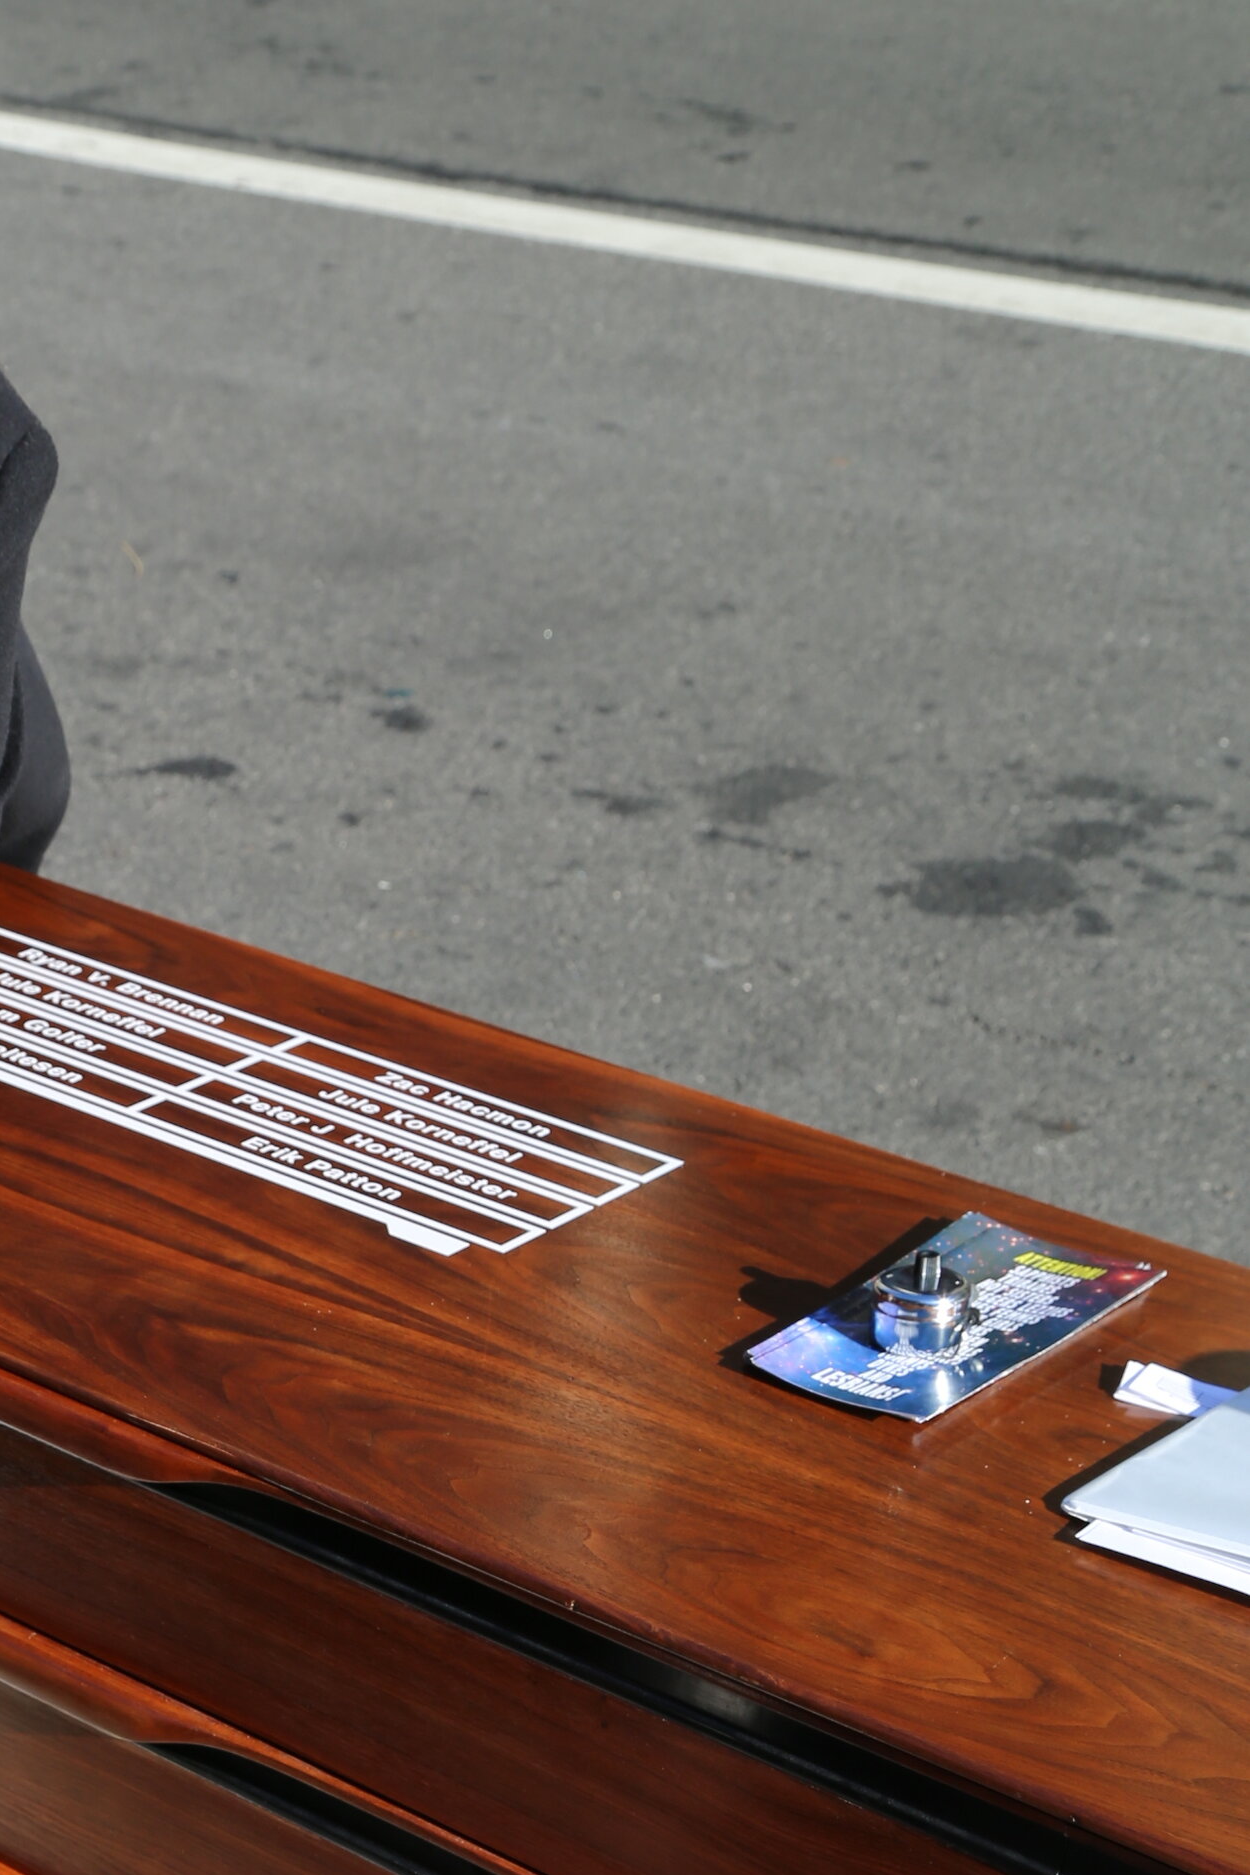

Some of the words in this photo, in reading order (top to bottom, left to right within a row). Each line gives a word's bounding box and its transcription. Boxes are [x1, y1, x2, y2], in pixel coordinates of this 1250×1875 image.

[17, 947, 83, 977] Ryan
[86, 970, 111, 987] V.
[115, 981, 225, 1026] Brennan
[42, 990, 166, 1038] Korneffel
[318, 1087, 381, 1117] Jule
[383, 1108, 524, 1165] Korneffel
[374, 1070, 432, 1097] Zac
[433, 1090, 552, 1139] Hacmon
[231, 1092, 311, 1127] Peter
[311, 1121, 336, 1136] J
[343, 1132, 519, 1201] Hoffmeister
[240, 1135, 304, 1166] Erik
[304, 1157, 402, 1202] Patton
[1013, 1251, 1108, 1280] ATTENTION!
[810, 1367, 910, 1400] LESBIANS!
